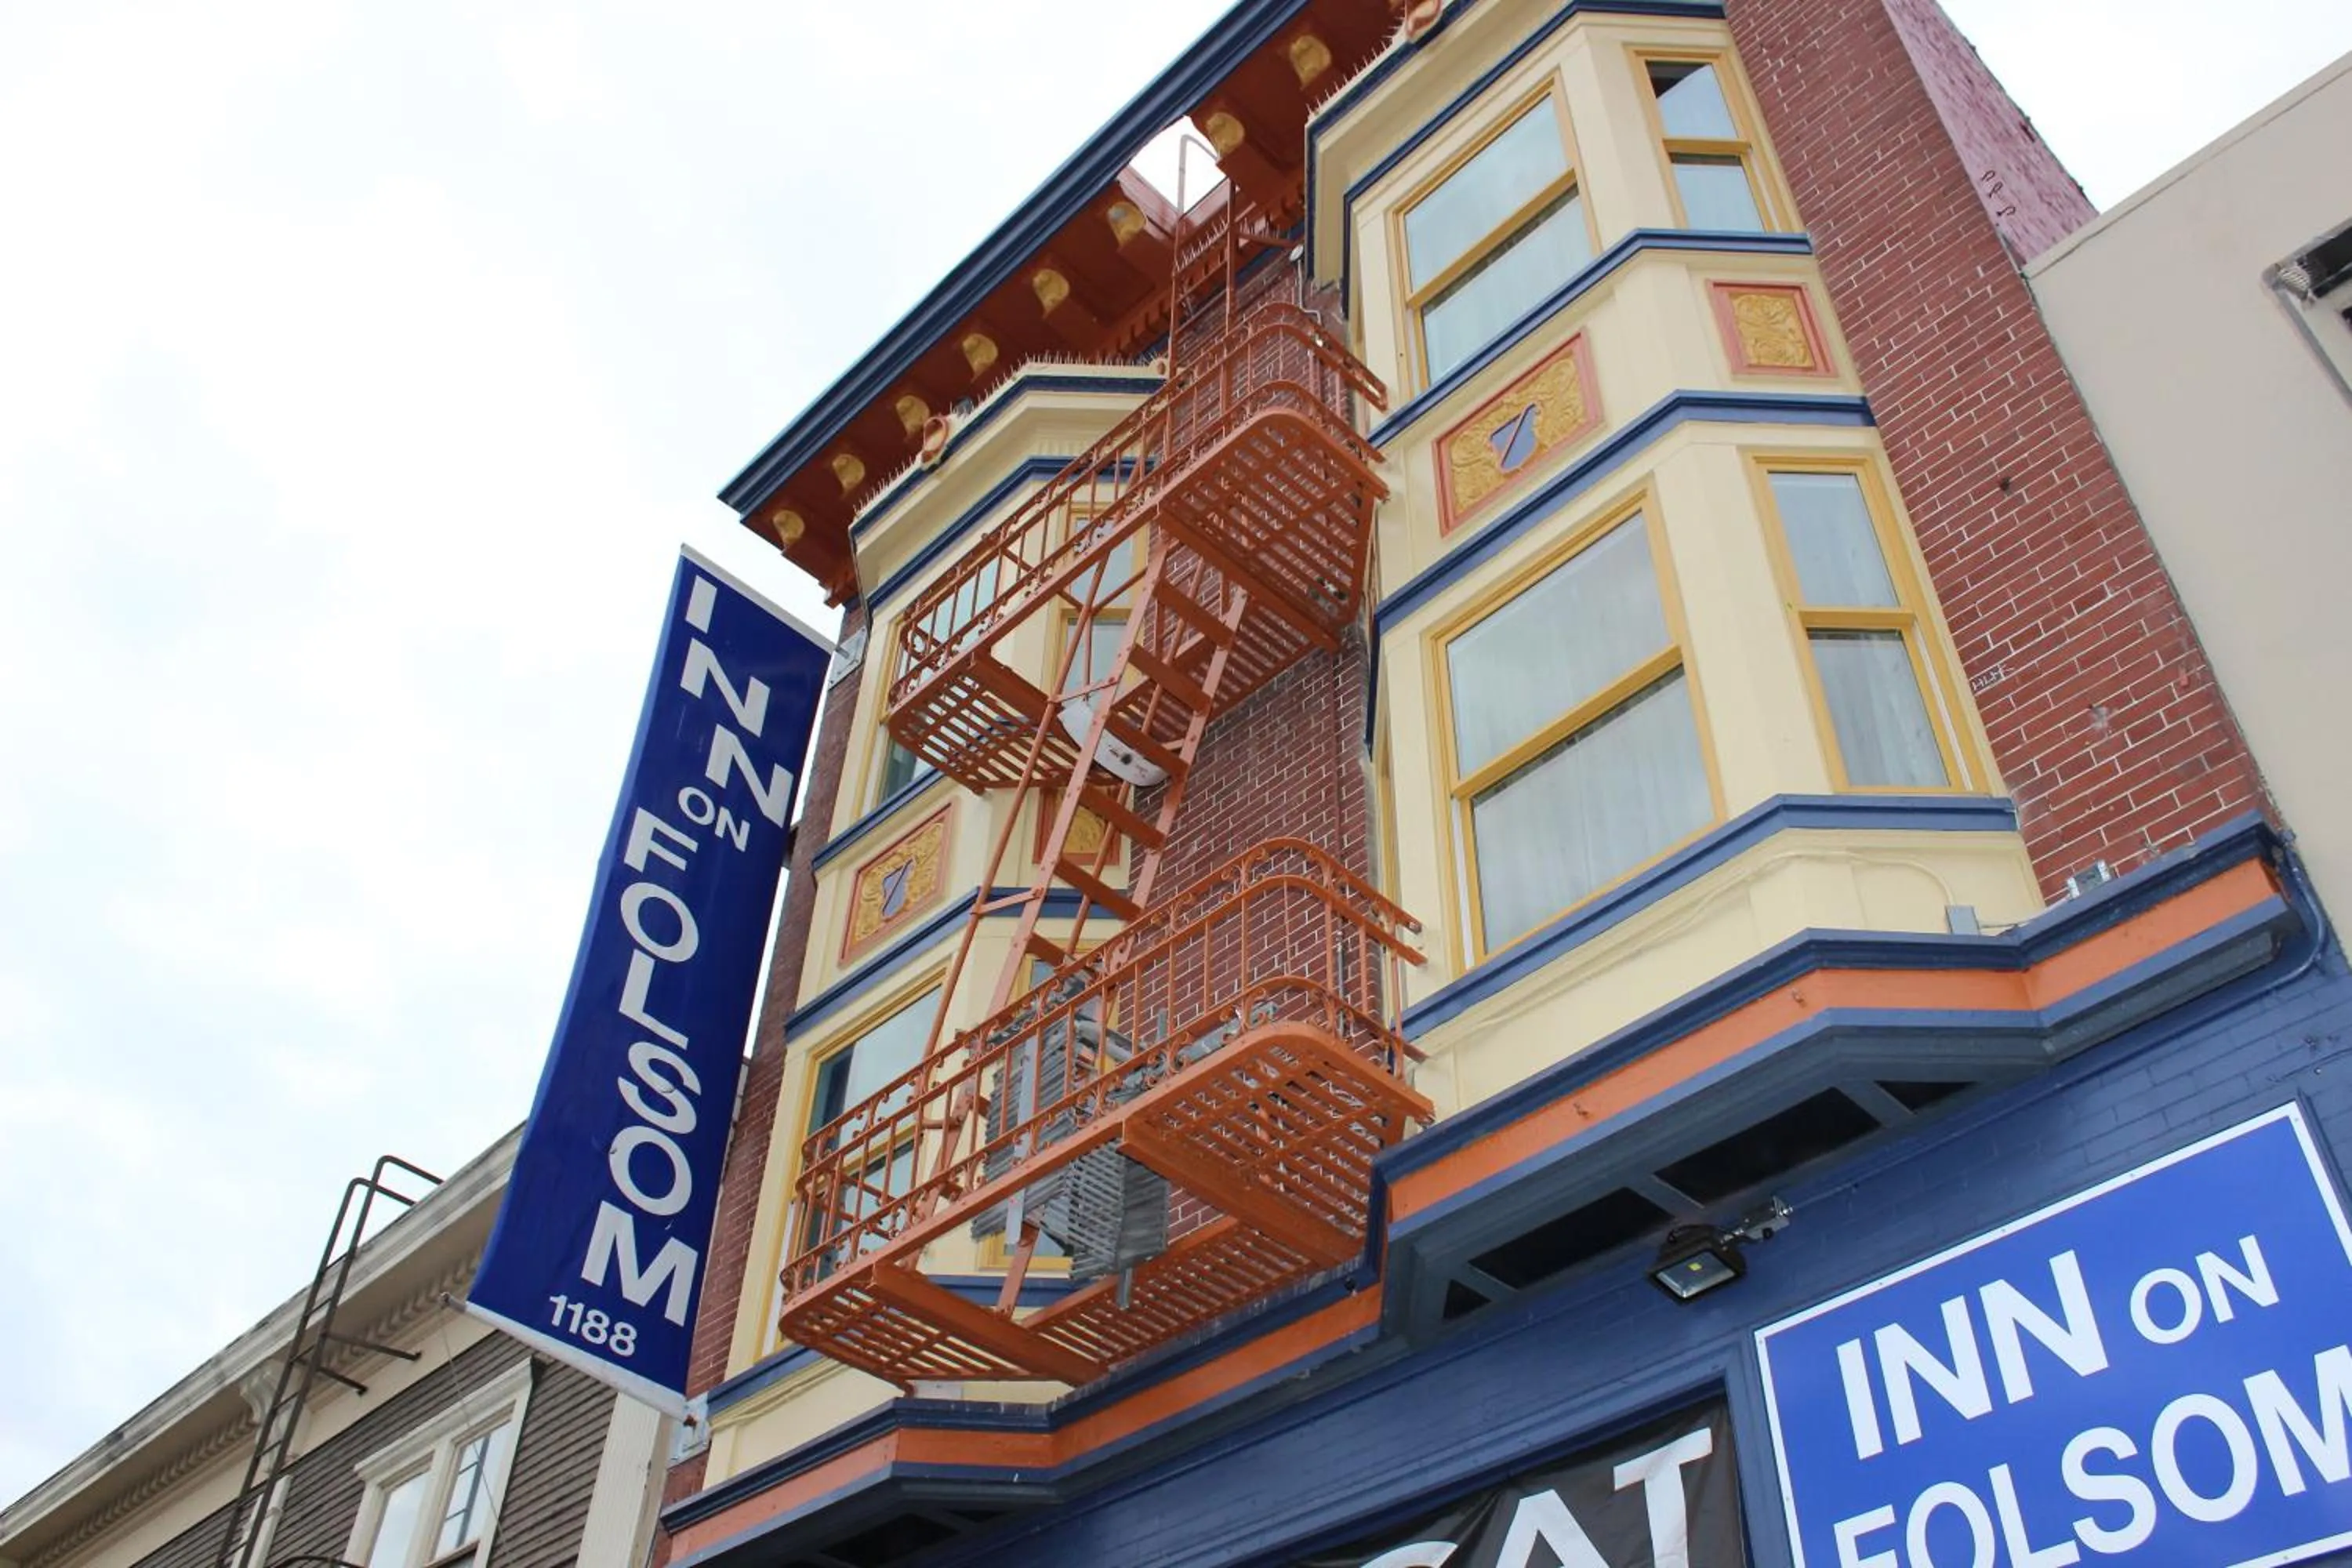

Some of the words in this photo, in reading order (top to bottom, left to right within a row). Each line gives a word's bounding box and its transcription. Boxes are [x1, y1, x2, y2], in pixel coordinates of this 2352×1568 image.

[681, 574, 794, 829] INN
[678, 786, 750, 852] ON
[581, 806, 702, 1327] FOLSOM
[550, 1294, 637, 1357] 1188
[1836, 1249, 2109, 1461] INN
[2130, 1234, 2280, 1345] ON
[1358, 1427, 1713, 1568] AT
